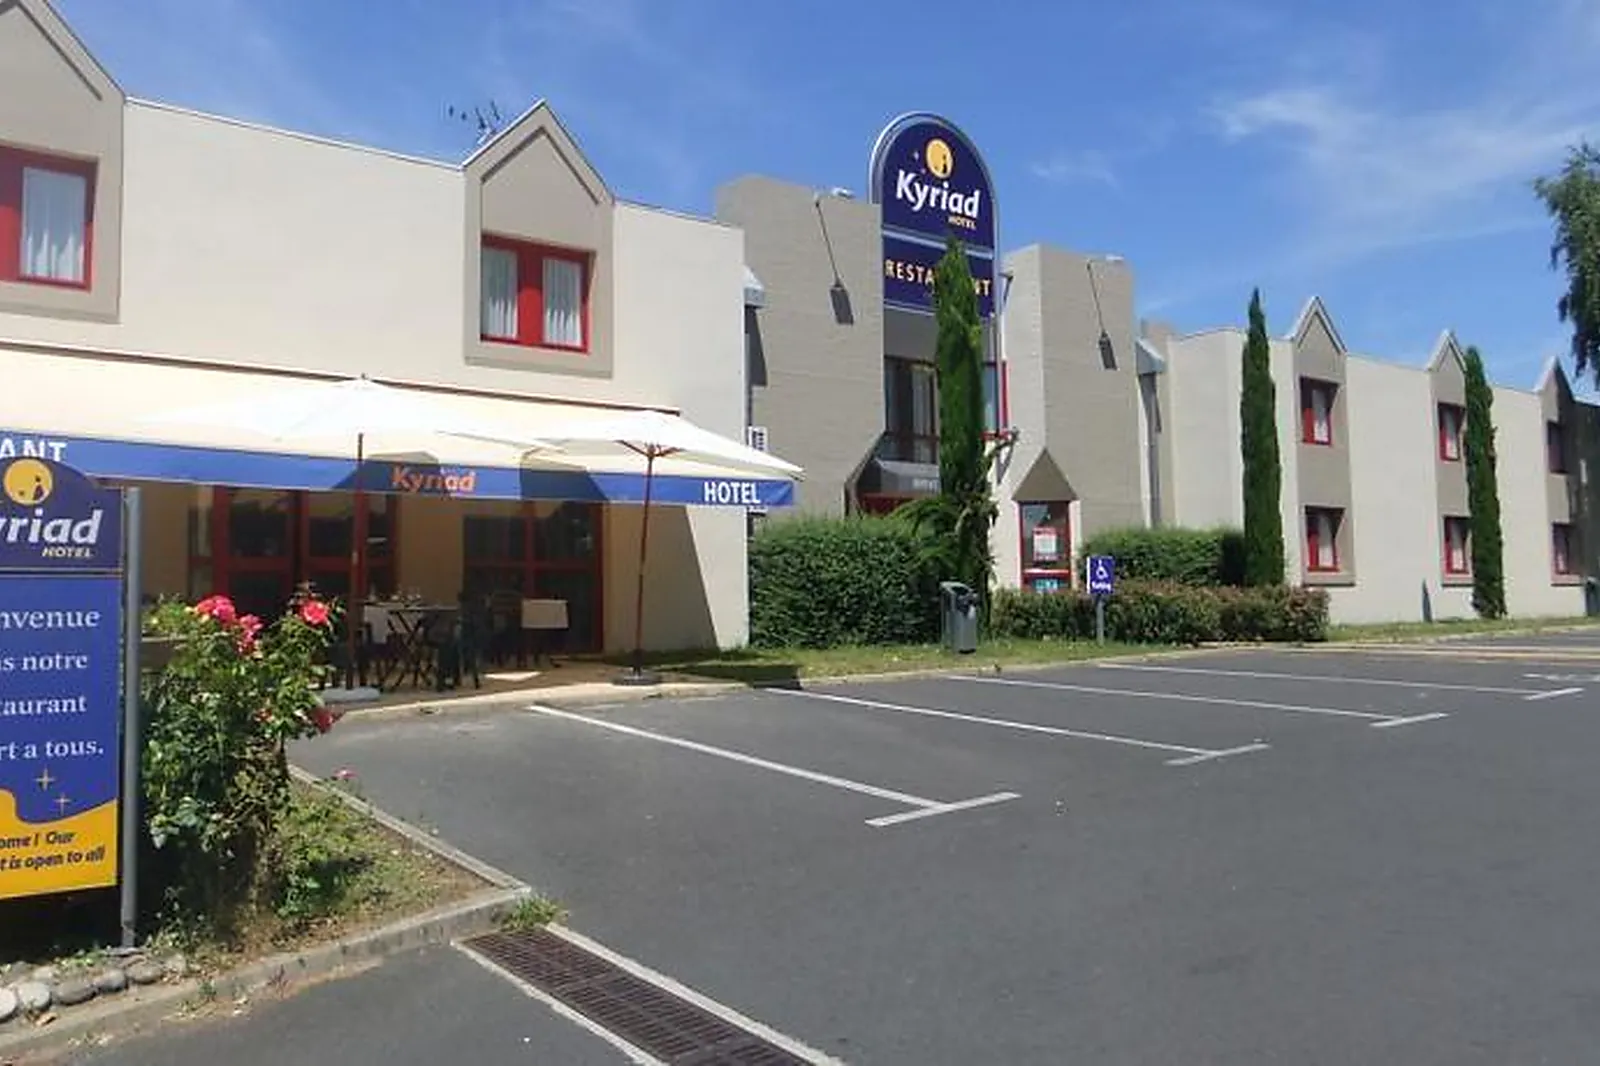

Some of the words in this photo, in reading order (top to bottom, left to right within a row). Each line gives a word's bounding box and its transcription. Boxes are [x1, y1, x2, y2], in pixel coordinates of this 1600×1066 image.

[896, 168, 981, 219] Kyriad
[947, 215, 977, 230] HOTEL
[884, 259, 991, 296] RESTANT
[703, 481, 761, 504] HOTEL
[41, 546, 94, 557] HOTEL
[0, 609, 101, 629] nvenue
[22, 653, 88, 670] notre
[0, 696, 87, 715] aurant
[45, 740, 104, 757] tous.
[25, 854, 63, 870] open
[67, 851, 82, 862] to
[86, 844, 105, 862] all
